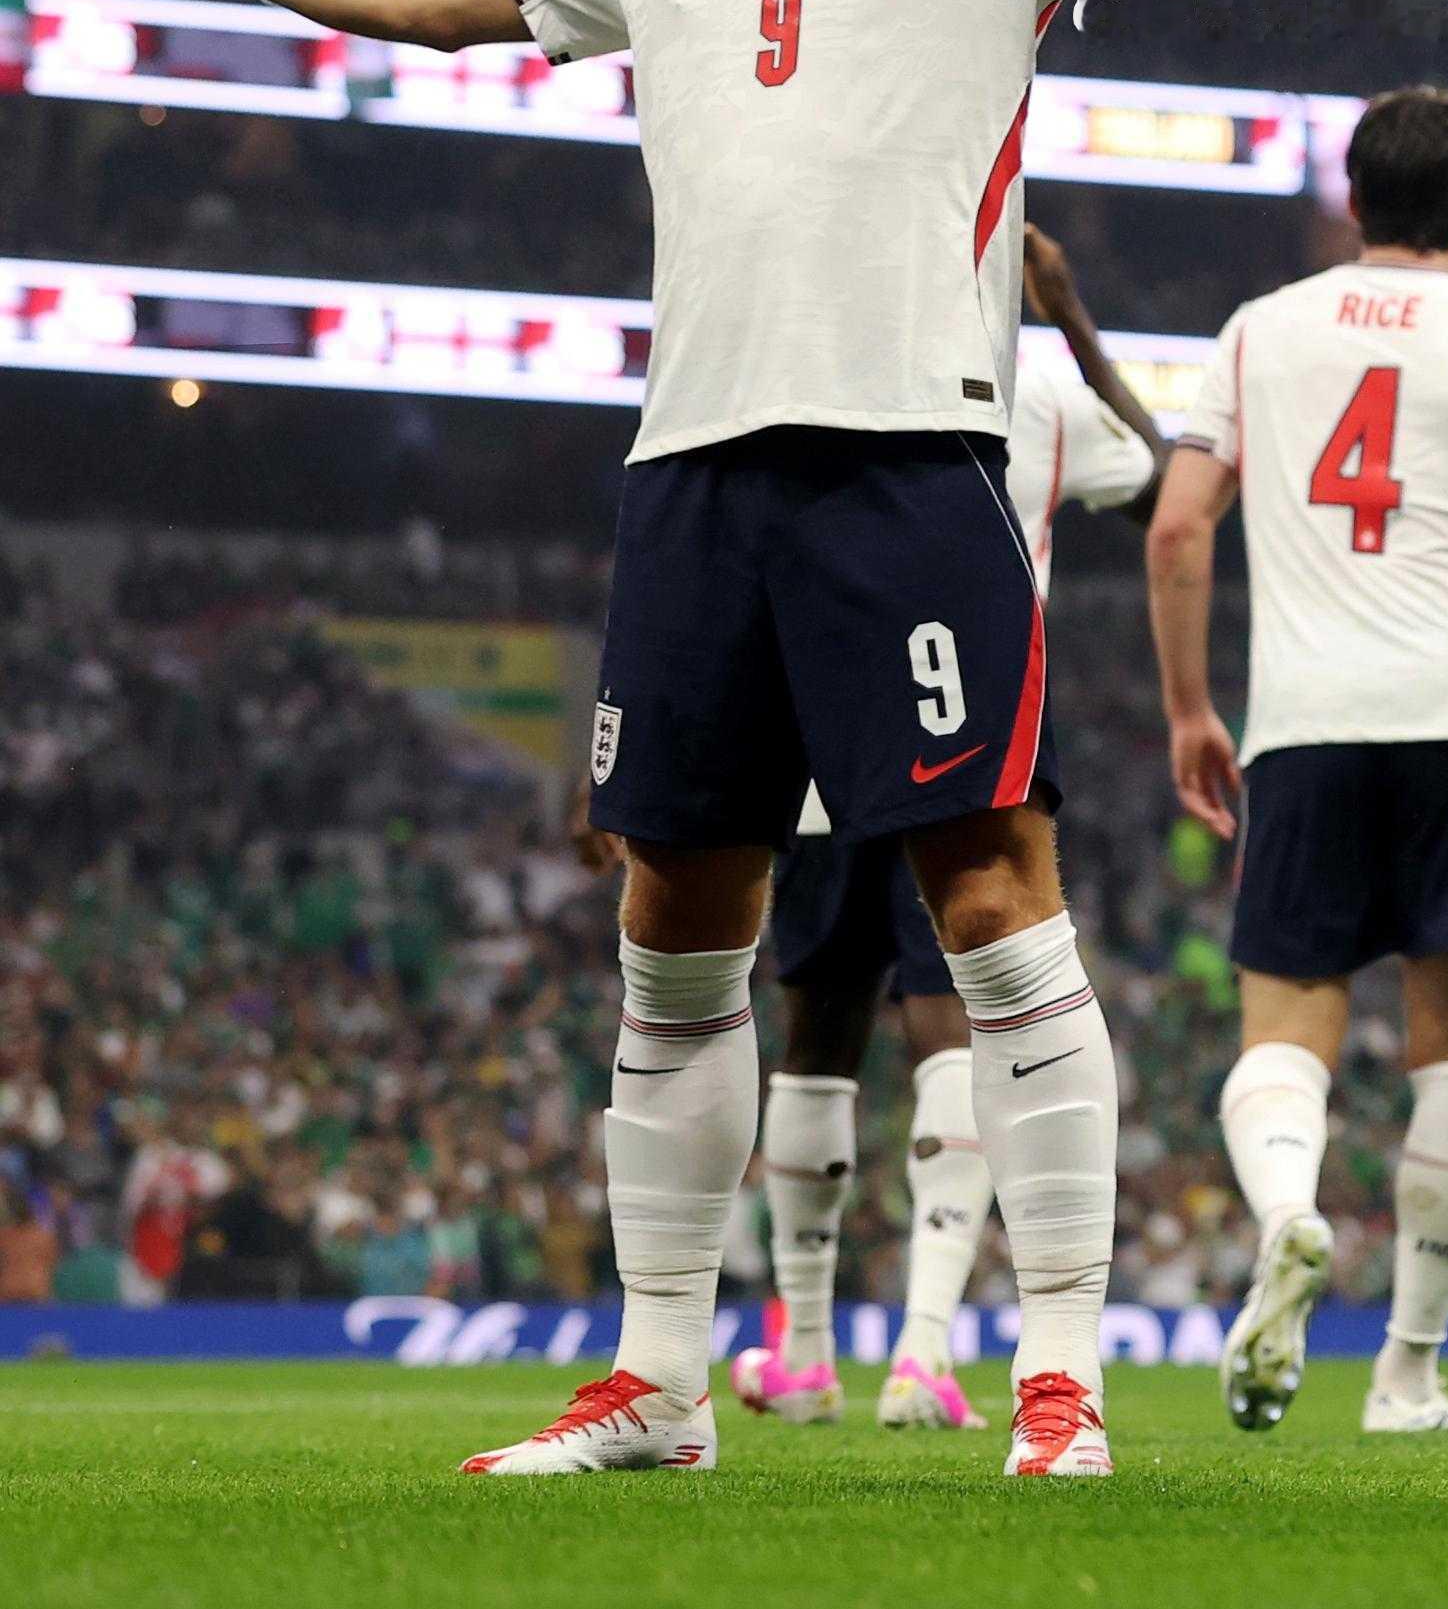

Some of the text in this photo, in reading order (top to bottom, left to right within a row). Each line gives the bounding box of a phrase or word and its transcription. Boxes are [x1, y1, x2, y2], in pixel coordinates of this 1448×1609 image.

[1337, 293, 1425, 329] RICE
[1308, 365, 1403, 555] 4
[907, 621, 967, 736] 9
